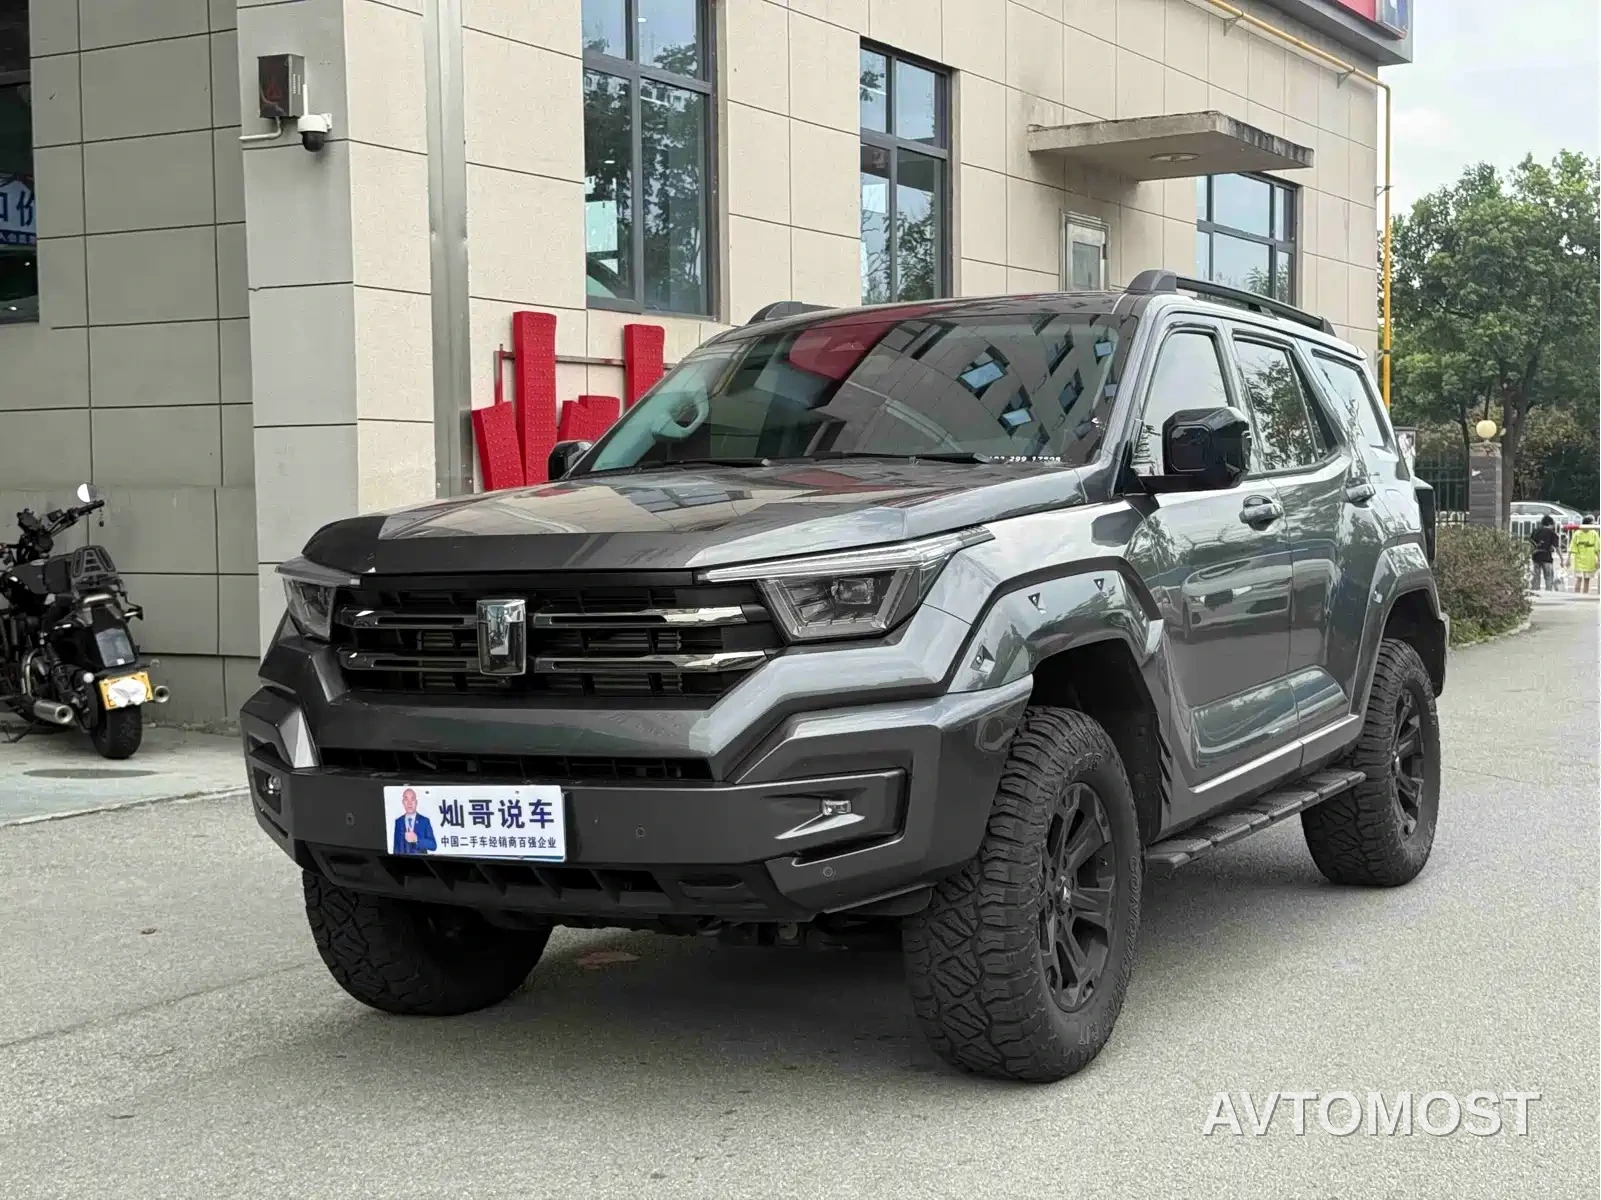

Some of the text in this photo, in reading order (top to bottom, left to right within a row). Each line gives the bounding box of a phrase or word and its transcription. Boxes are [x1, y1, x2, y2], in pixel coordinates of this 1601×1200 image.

[439, 799, 554, 829] 灿哥说车
[441, 835, 557, 849] 中国二手车经销商百强企业
